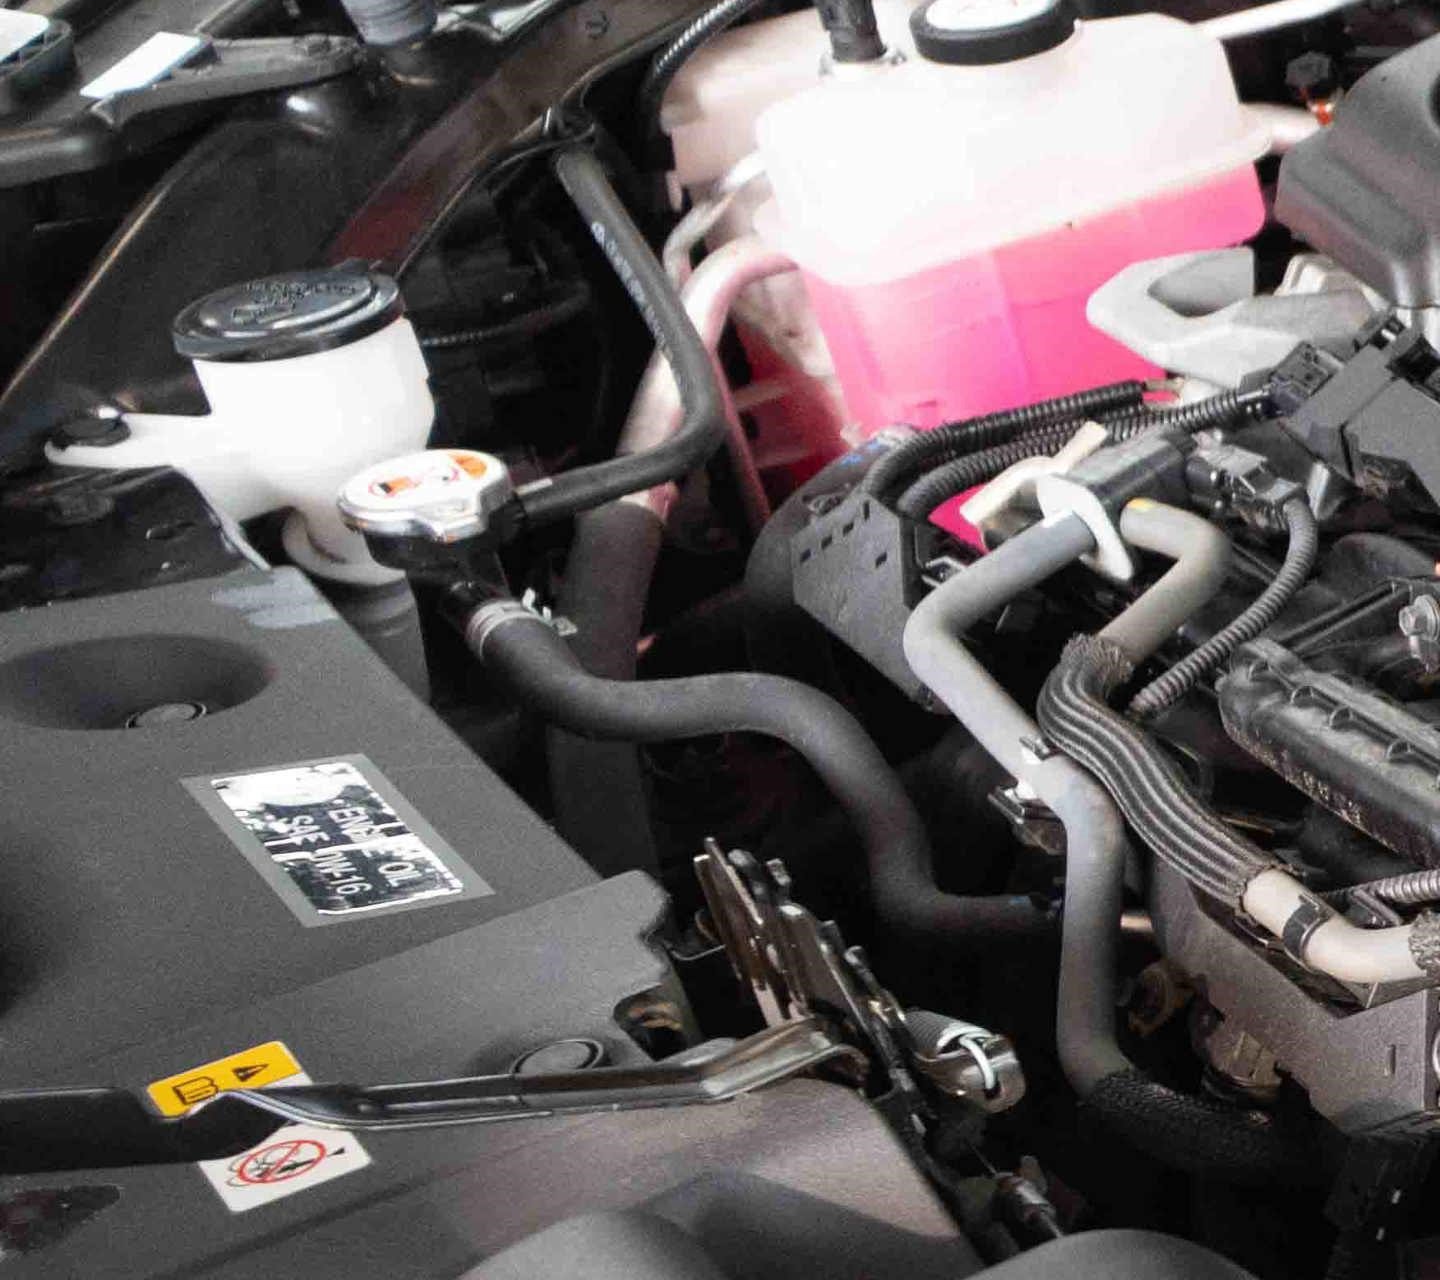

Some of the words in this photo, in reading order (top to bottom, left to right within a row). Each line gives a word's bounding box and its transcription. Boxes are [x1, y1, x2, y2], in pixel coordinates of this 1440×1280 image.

[289, 814, 332, 845] SAE
[310, 850, 373, 896] 0W-16
[378, 861, 423, 888] OIL
